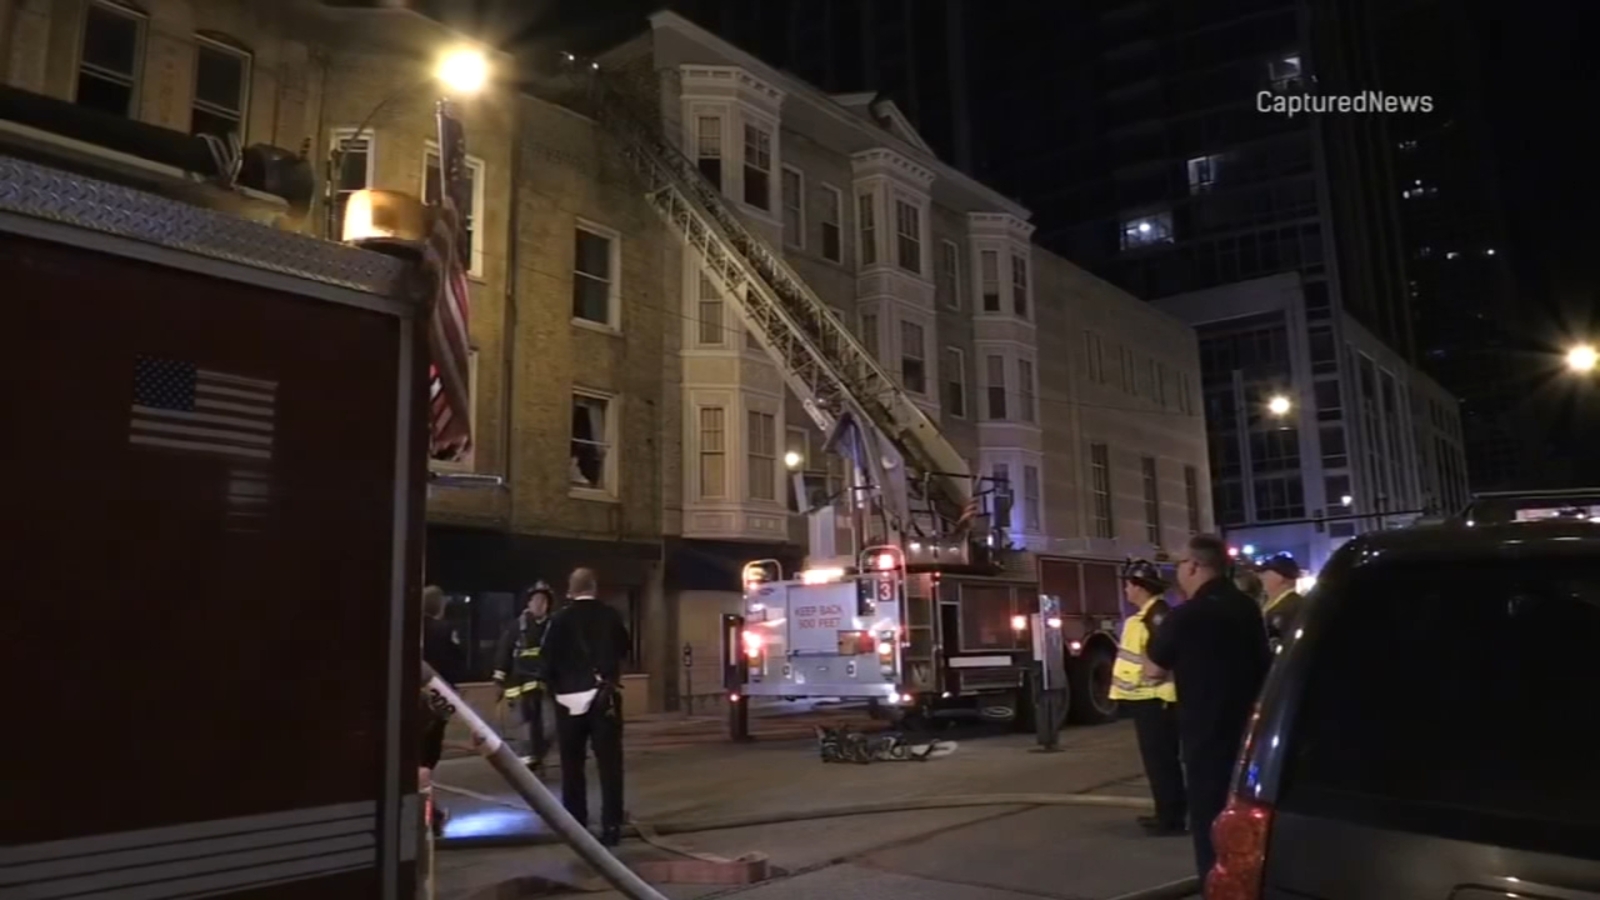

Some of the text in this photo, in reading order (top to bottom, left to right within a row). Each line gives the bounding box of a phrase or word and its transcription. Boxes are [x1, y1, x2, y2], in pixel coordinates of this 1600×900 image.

[879, 583, 891, 601] 3
[795, 604, 843, 617] KEEP BACK
[818, 617, 841, 629] FEET
